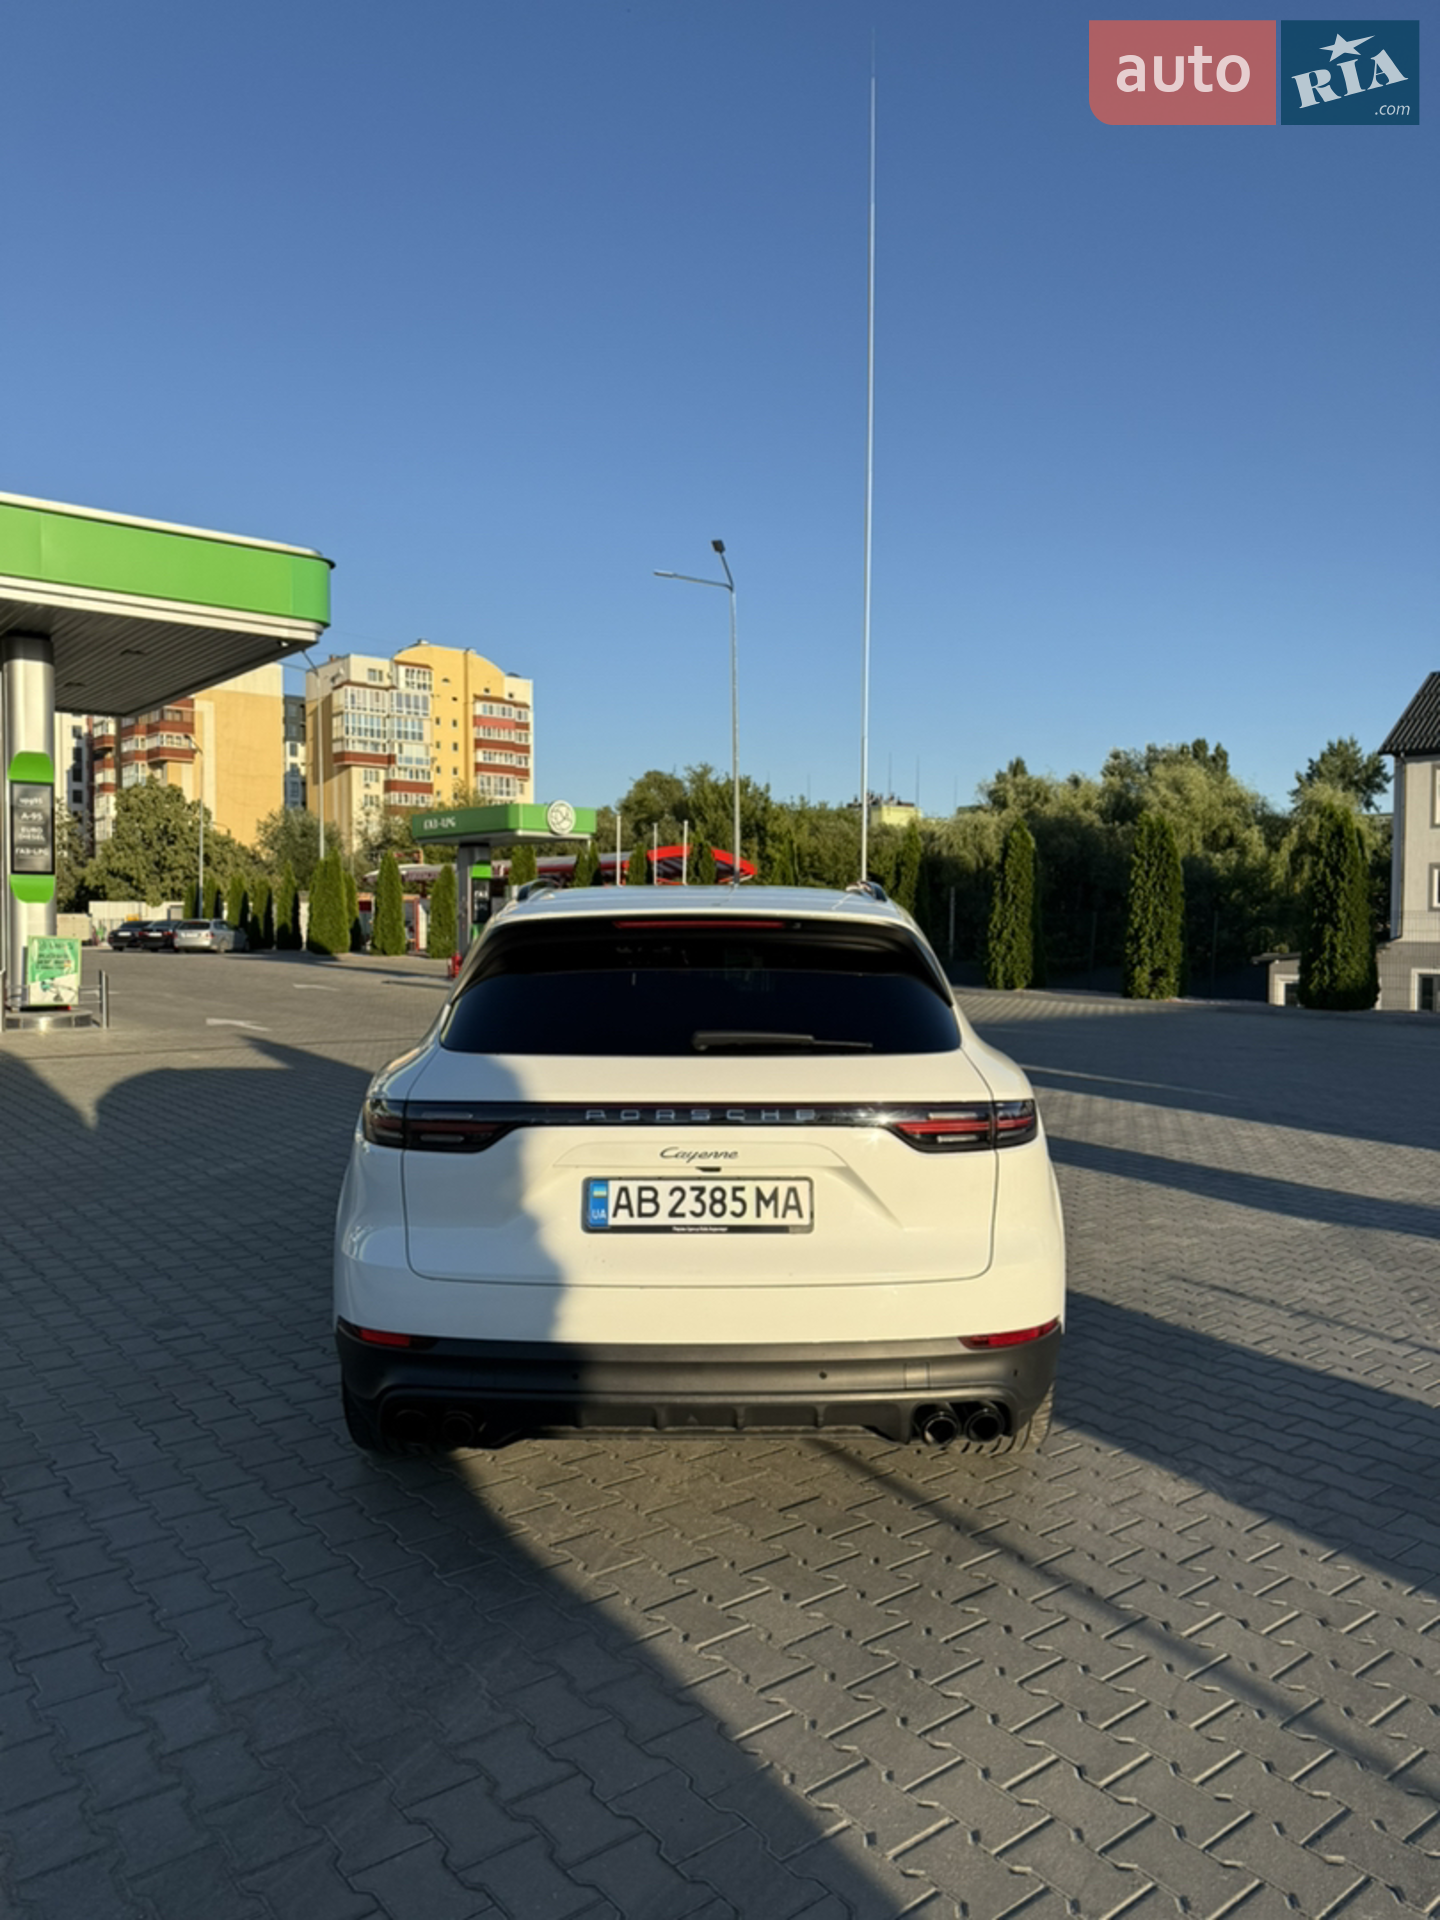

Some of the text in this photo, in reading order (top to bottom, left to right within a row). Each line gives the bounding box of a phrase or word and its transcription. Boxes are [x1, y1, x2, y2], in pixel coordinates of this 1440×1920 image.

[585, 1109, 816, 1121] PORSCHE
[660, 1146, 739, 1163] Cayenne
[612, 1185, 804, 1219] AB 2385 MA
